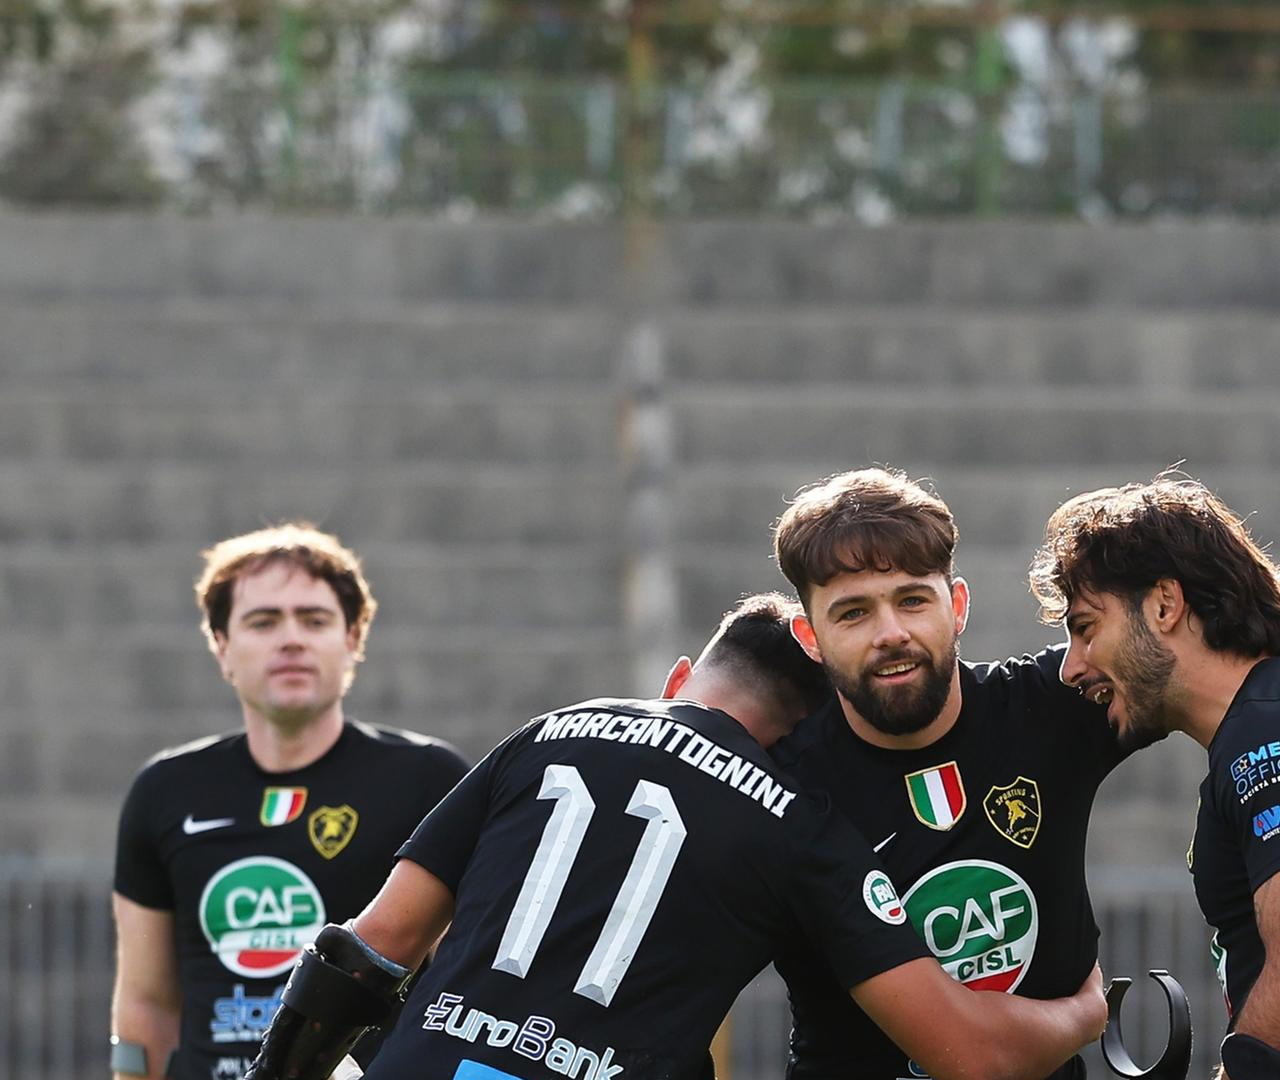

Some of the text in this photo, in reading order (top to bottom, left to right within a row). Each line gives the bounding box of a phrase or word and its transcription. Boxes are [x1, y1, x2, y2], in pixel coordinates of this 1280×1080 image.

[534, 711, 798, 819] MARCANTOGNINI
[225, 886, 313, 929] CAF
[491, 763, 687, 1008] 11
[249, 928, 299, 949] CISL
[923, 883, 1026, 958] CAF
[957, 945, 1022, 982] CISL
